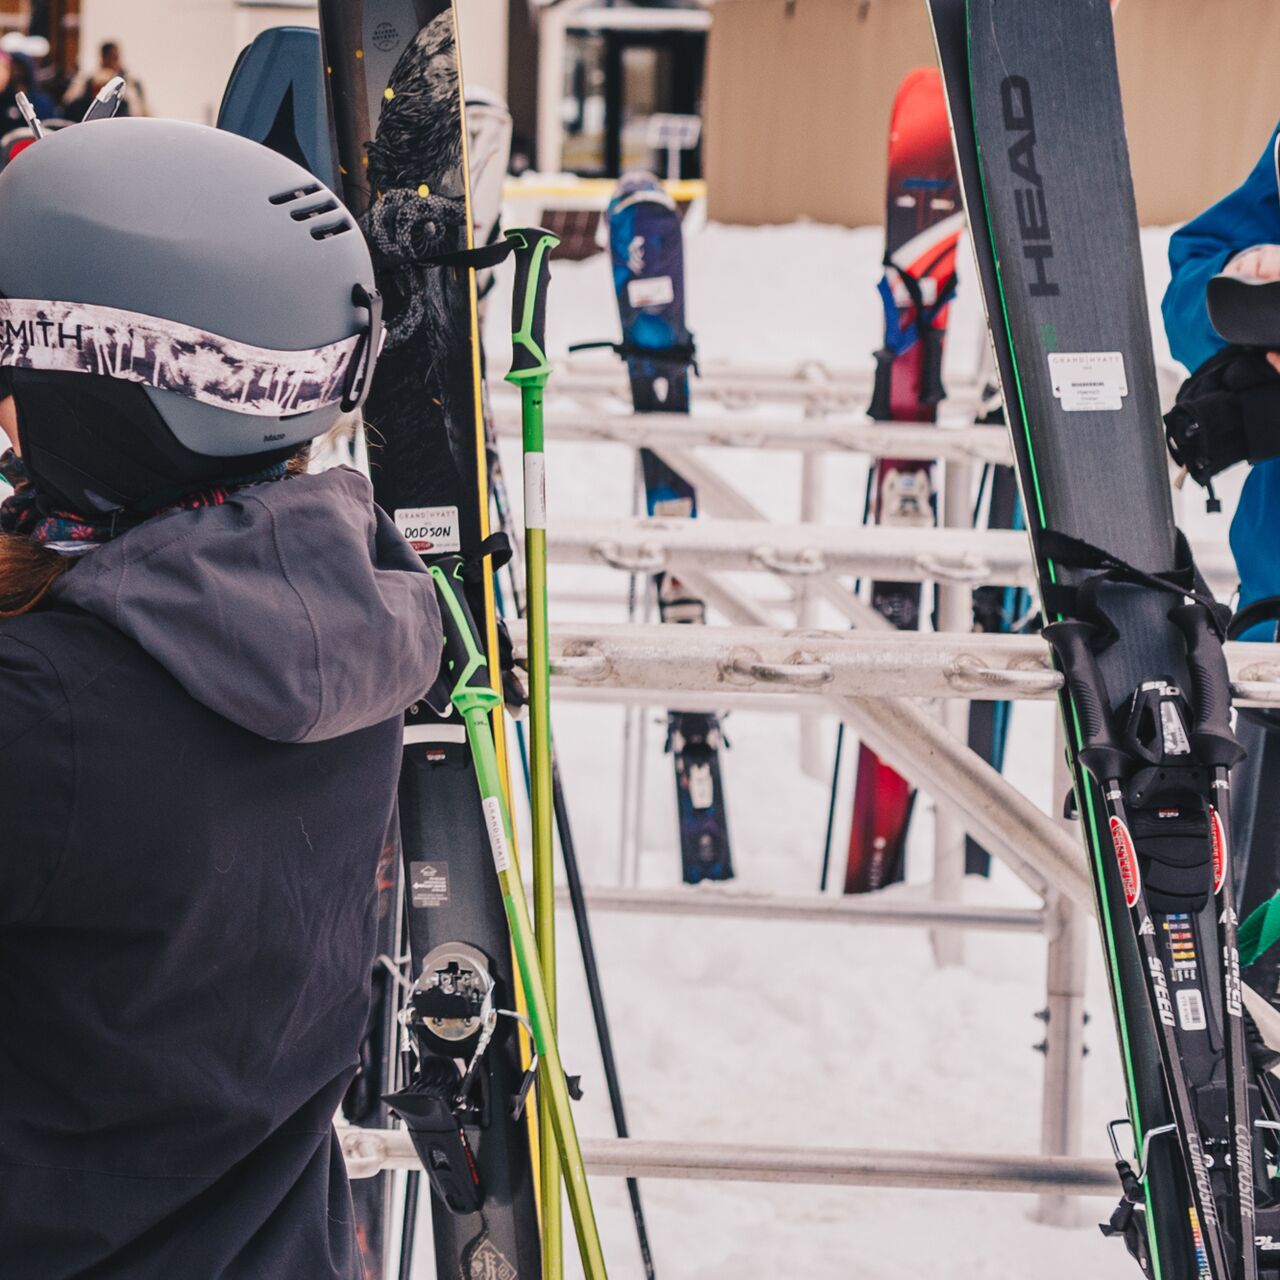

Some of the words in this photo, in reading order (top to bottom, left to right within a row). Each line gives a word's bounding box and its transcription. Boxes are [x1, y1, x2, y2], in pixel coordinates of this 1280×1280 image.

[1000, 75, 1059, 297] HEAD
[405, 526, 452, 539] DODSON
[430, 510, 456, 518] HYATT
[1148, 956, 1176, 1027] SPEED
[1187, 1132, 1217, 1226] COMPOSITE
[1235, 1124, 1252, 1218] COMPOSITE
